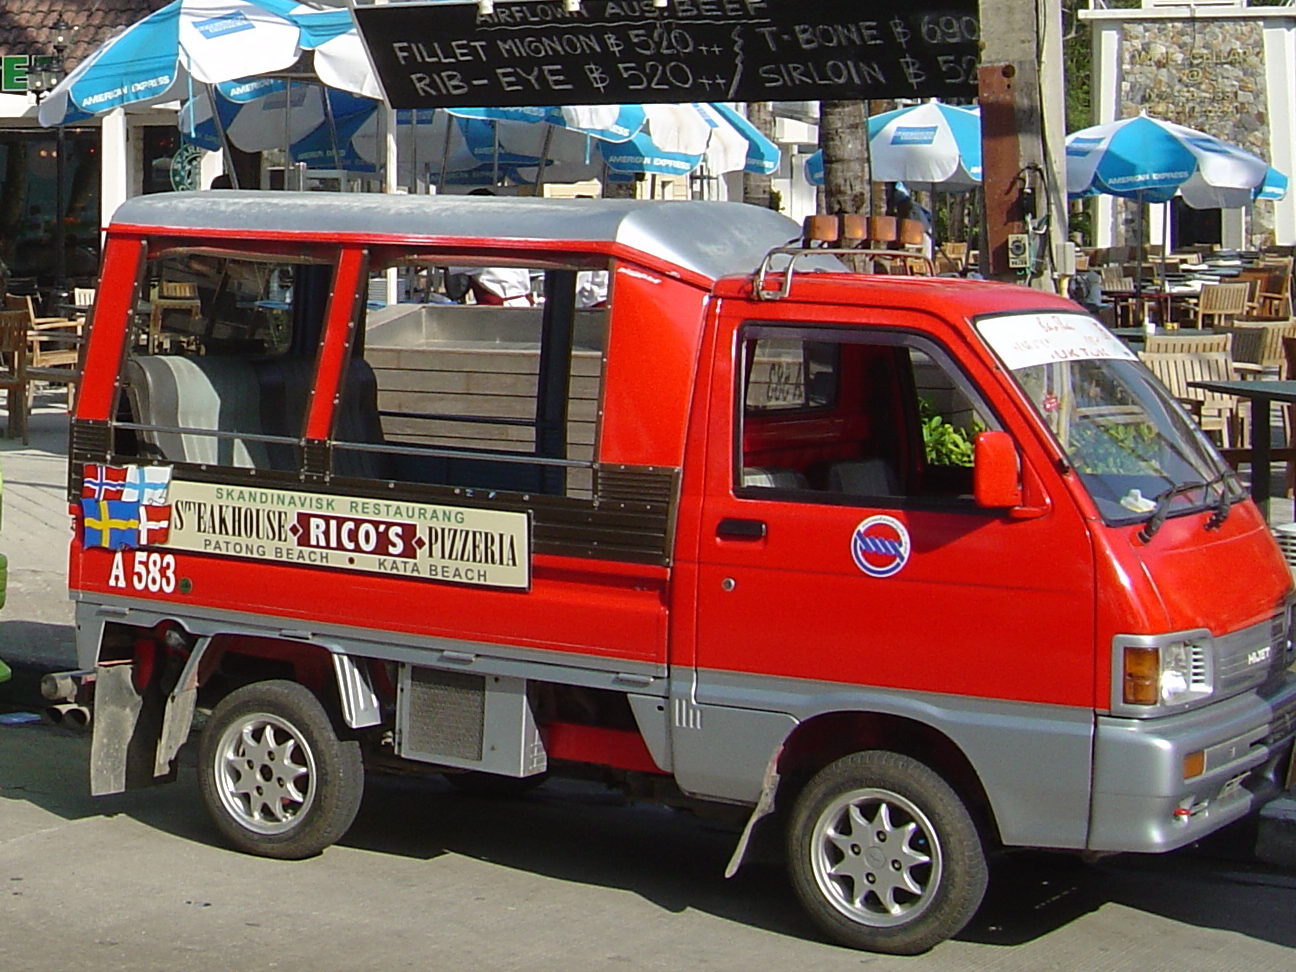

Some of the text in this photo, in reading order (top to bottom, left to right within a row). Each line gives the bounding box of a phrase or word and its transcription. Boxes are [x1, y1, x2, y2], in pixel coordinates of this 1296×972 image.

[393, 40, 489, 65] FILLET
[495, 32, 602, 60] MIGNON
[628, 28, 694, 56] 520
[755, 20, 884, 52] T-BONE
[82, 74, 170, 107] AMERICAN EXPRESS
[617, 61, 693, 90] 520
[758, 59, 887, 88] SIRLOIN
[609, 155, 693, 170] AMERICAN EXPRESS
[1108, 170, 1189, 185] AMERICAN EXPRESS
[215, 487, 466, 525] SKANDINAVISK RESTAURANG
[174, 499, 517, 568] STEAKHOUSE RICO'S PIZZERIA
[108, 549, 176, 593] A 583
[204, 538, 488, 583] PATONG BEACH KATA BEACH
